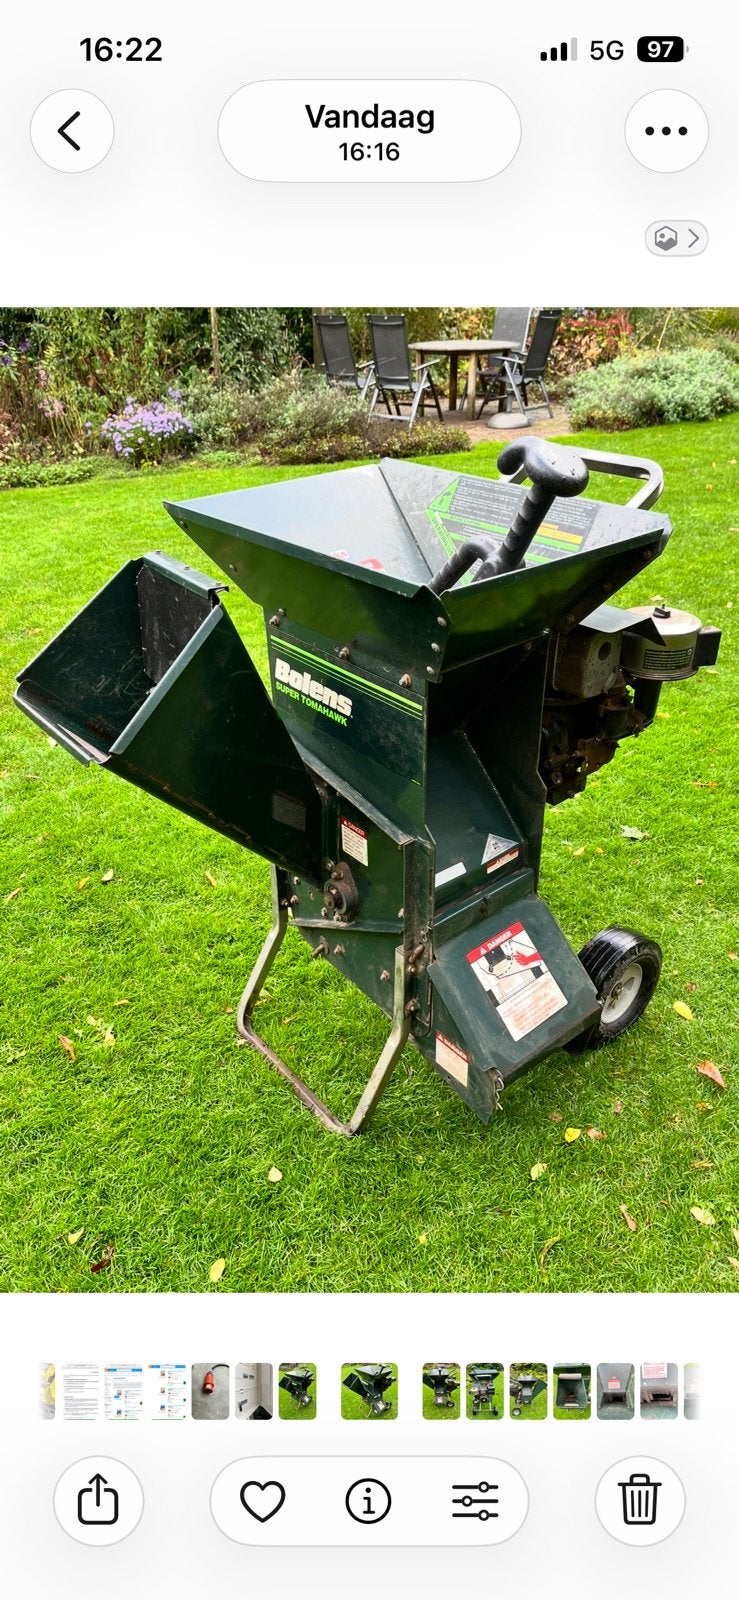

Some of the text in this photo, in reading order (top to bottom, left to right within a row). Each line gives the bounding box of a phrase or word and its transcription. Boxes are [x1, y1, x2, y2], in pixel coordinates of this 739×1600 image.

[80, 37, 163, 62] 16:22
[590, 40, 674, 61] 5G 97
[304, 104, 435, 135] Vandaag
[338, 142, 400, 162] 16:16
[274, 657, 353, 718] Bolens
[275, 681, 348, 727] SUPER TOMAHAWK
[487, 930, 513, 951] DANGER
